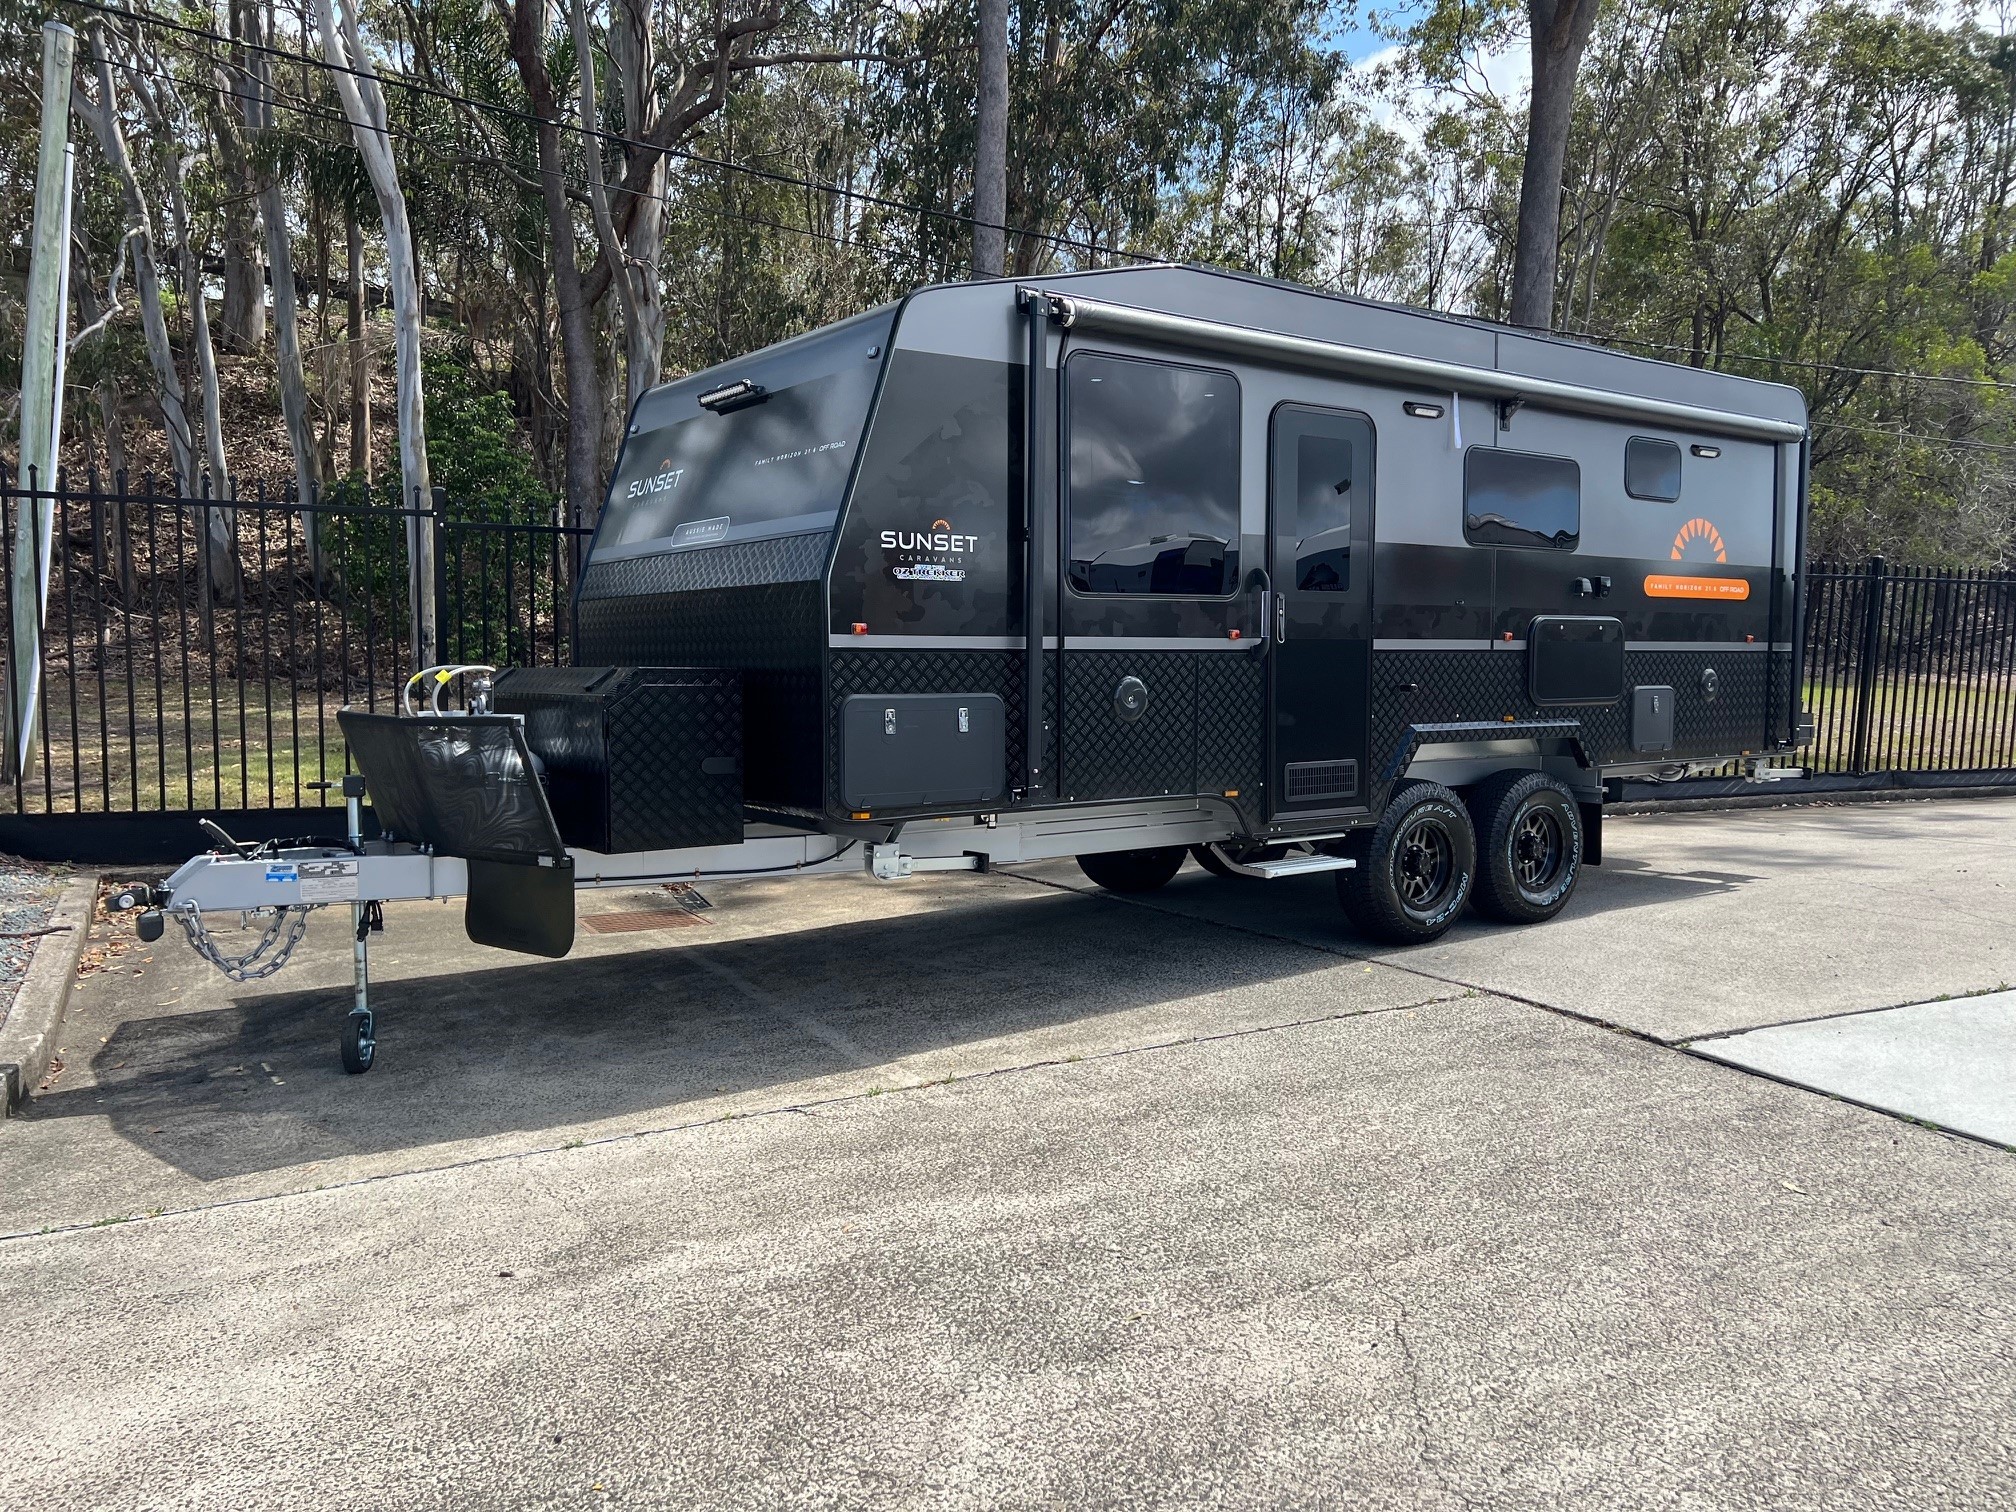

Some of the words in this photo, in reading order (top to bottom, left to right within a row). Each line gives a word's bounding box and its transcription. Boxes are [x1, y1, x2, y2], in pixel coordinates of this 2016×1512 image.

[627, 469, 684, 499] SUNSET
[685, 525, 705, 535] AUSSIE
[707, 523, 723, 531] MADE
[880, 531, 977, 552] SUNSET
[899, 554, 962, 564] CARAVANS
[1675, 583, 1702, 591] HORIZON
